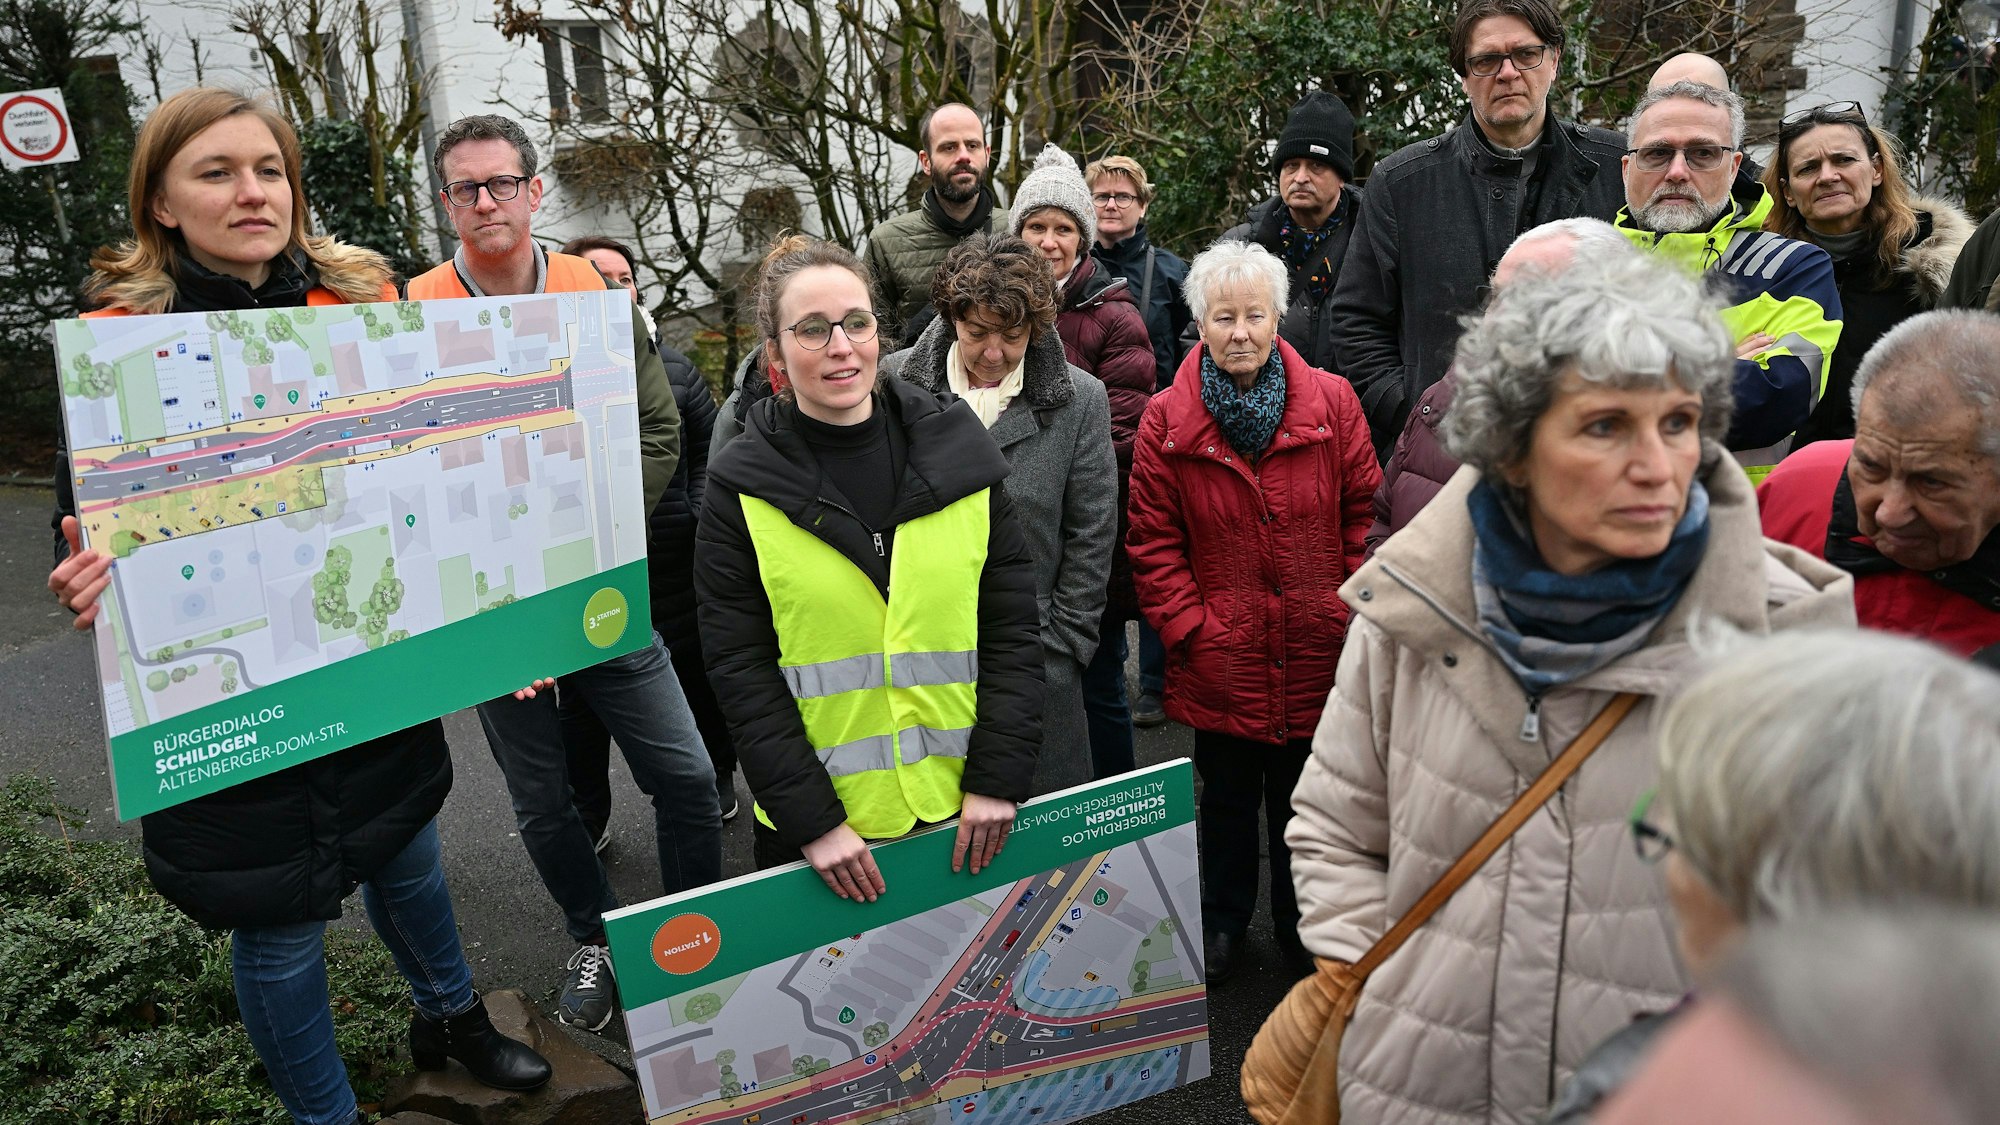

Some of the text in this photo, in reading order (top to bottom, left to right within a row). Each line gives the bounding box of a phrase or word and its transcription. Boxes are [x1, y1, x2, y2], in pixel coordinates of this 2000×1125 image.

[8, 110, 48, 120] Durchfahrt
[588, 607, 621, 629] 3. STATION
[153, 704, 285, 755] BÜRGERDIALOG
[155, 731, 258, 775] SCHILDGEN
[158, 722, 349, 794] ALTENBERGER-DOM-STR.
[1062, 808, 1166, 847] BÜRGERDIALOG
[1085, 794, 1166, 827] SCHILDGEN
[663, 931, 712, 957] 1. STATION
